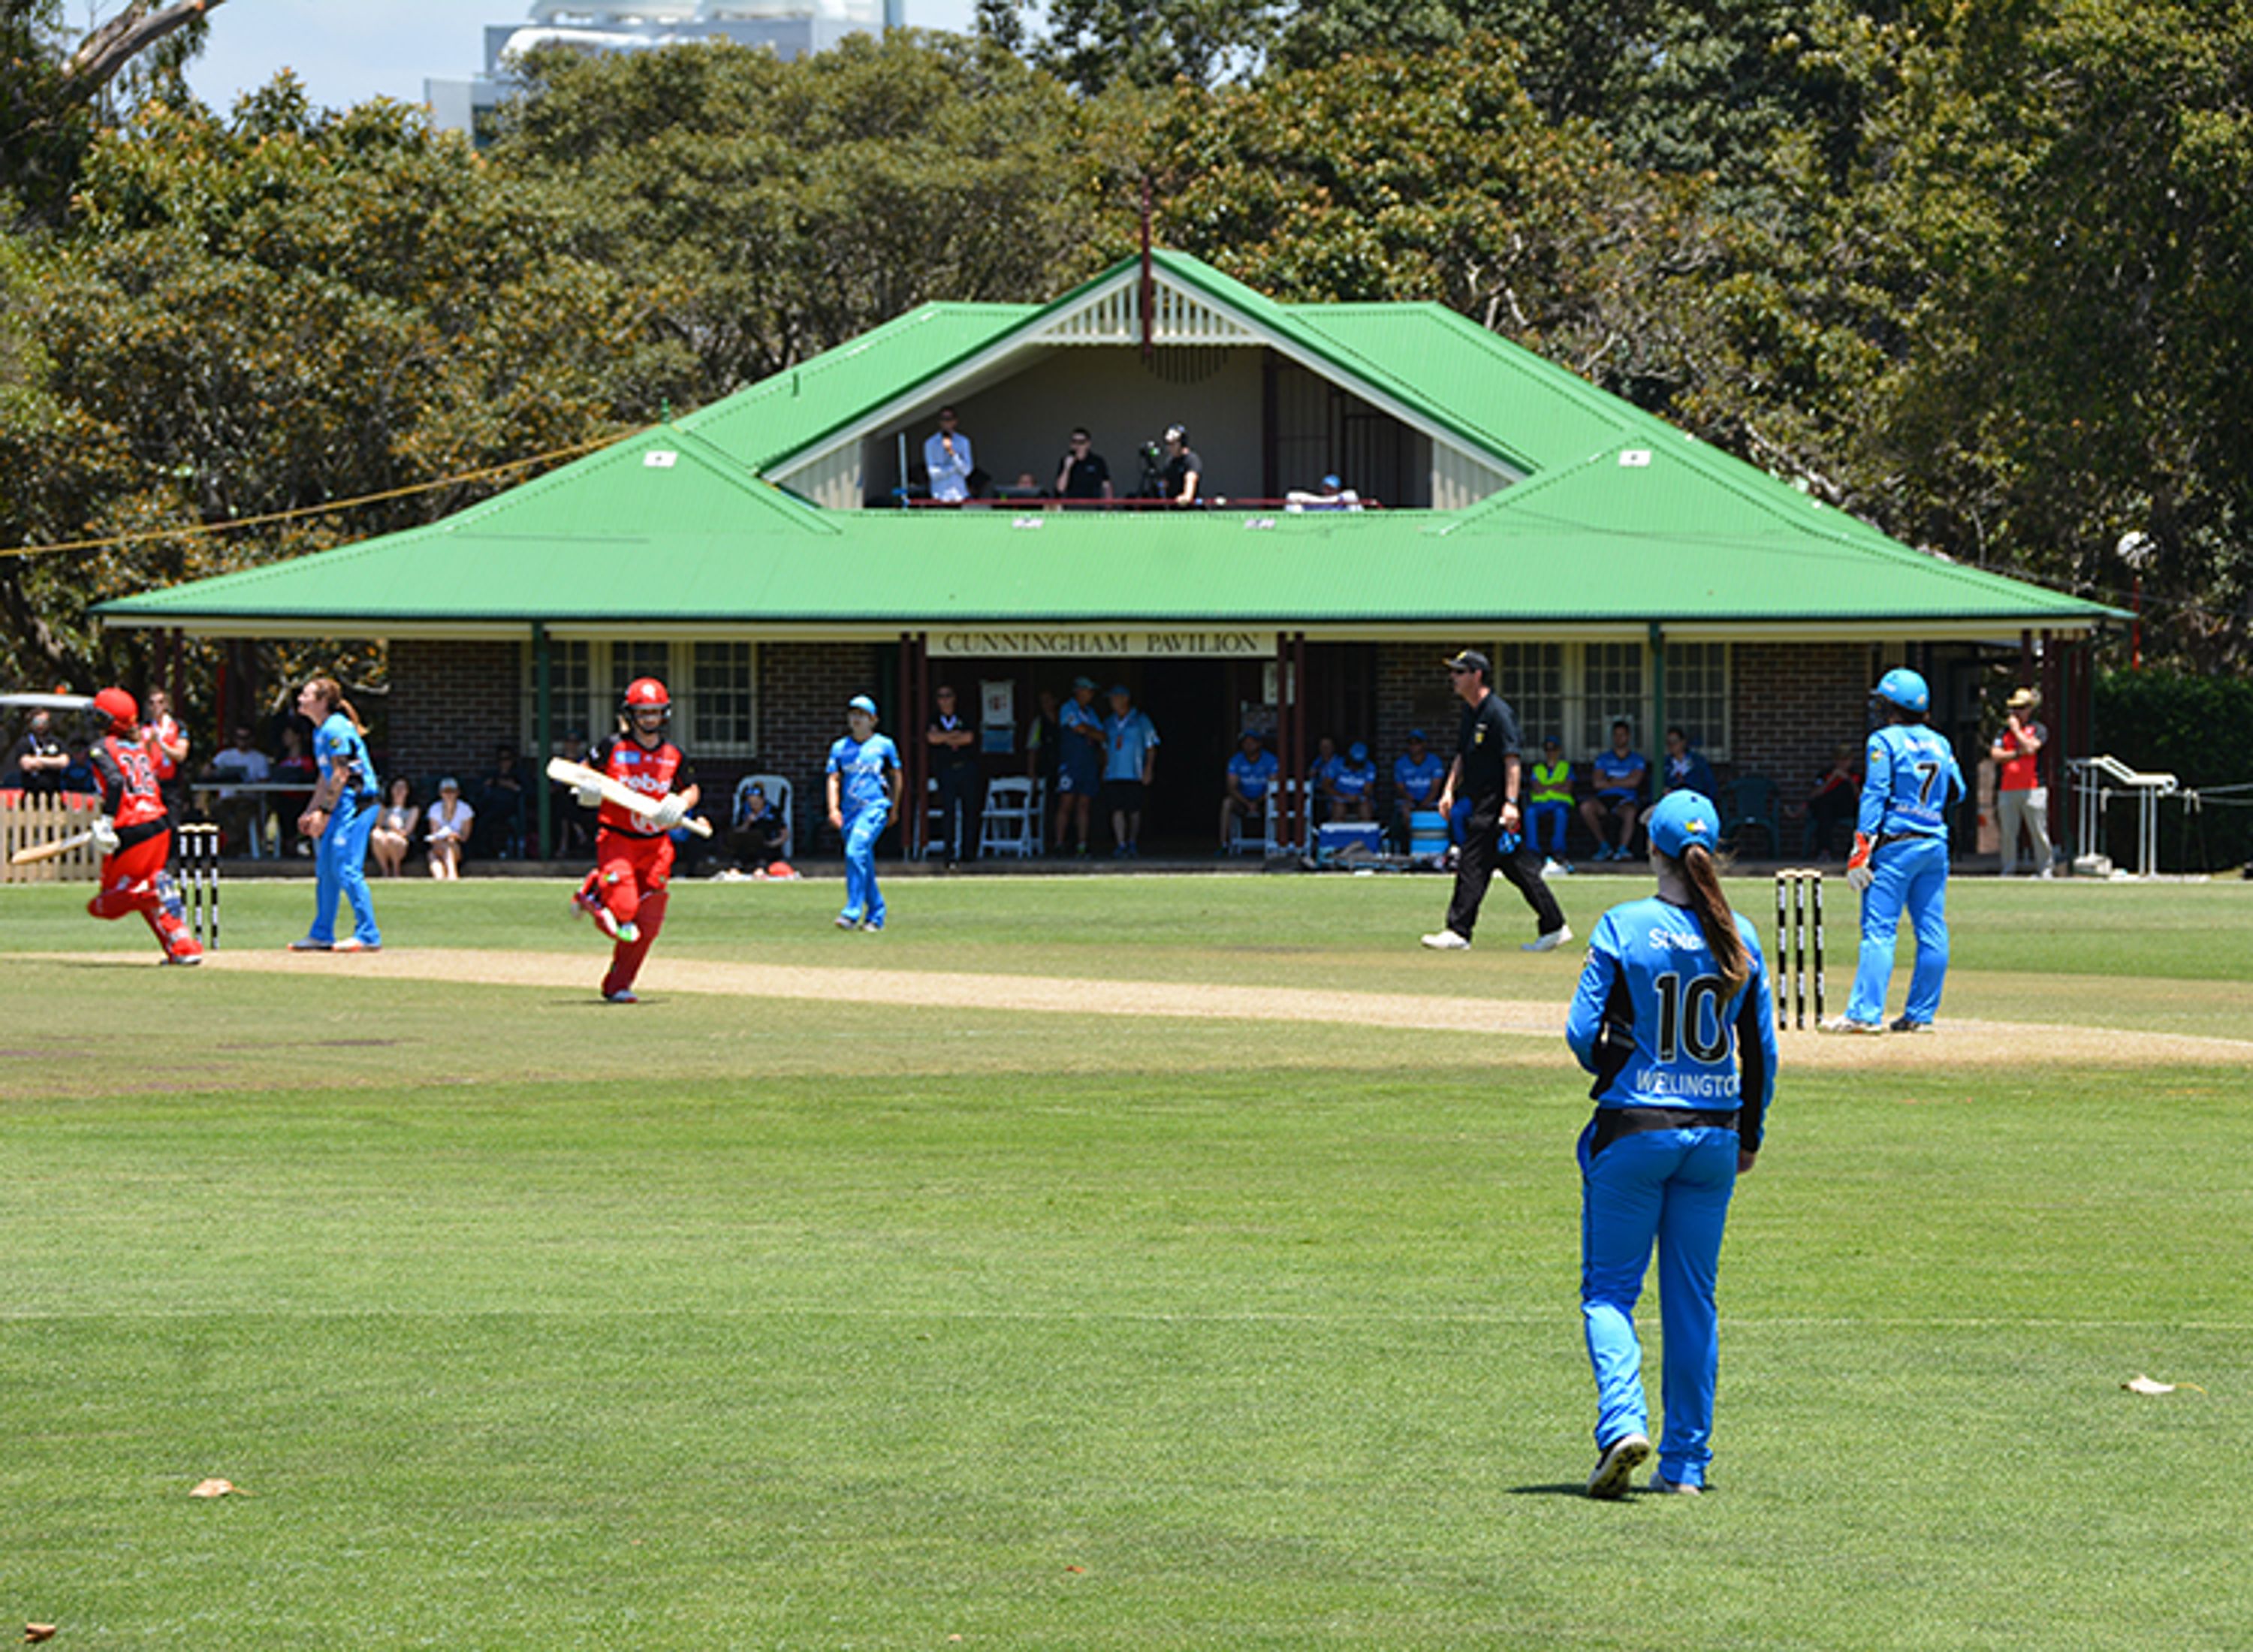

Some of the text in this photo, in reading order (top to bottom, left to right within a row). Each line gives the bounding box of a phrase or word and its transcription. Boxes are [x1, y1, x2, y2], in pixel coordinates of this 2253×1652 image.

[943, 632, 1260, 653] CUNNINGHAM PAVILION
[1914, 760, 1941, 807] 7
[1653, 972, 1730, 1065] 10
[1636, 1069, 1740, 1098] WELLINGTO
